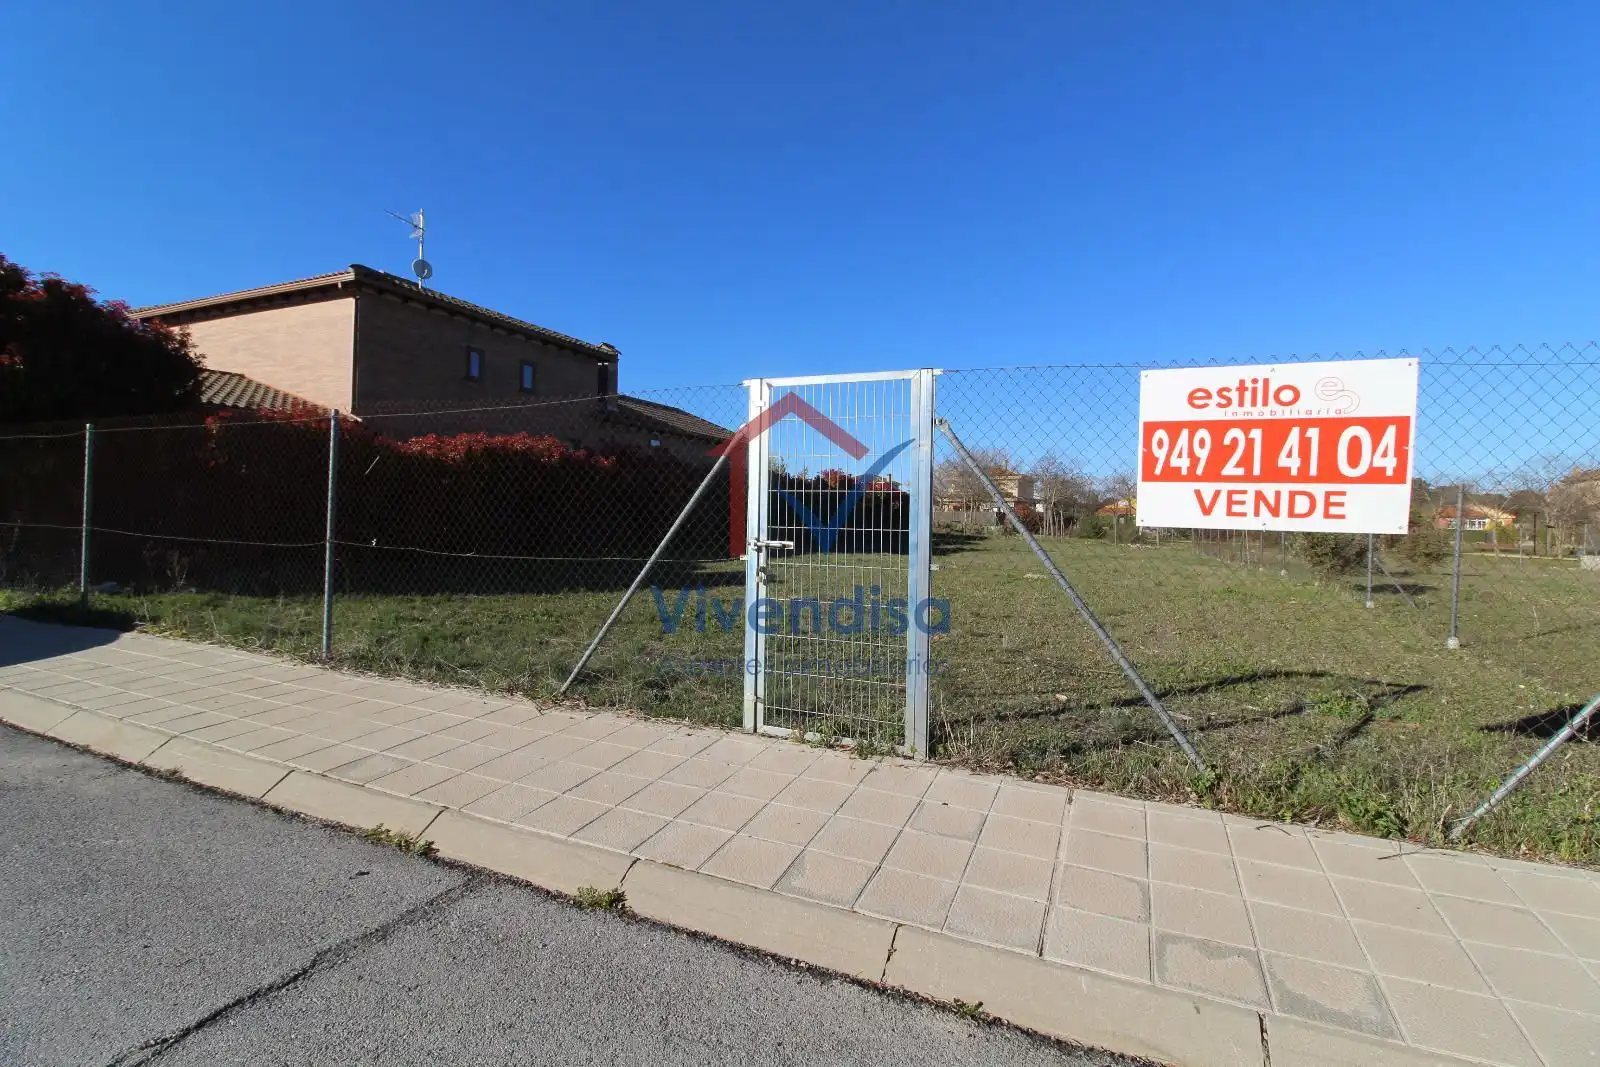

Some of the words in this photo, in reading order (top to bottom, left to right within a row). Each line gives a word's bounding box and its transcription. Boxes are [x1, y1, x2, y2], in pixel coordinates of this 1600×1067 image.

[1187, 377, 1301, 410] estilo
[1224, 407, 1342, 417] inmobiliaria
[1151, 428, 1212, 476] 949
[1220, 427, 1263, 476] 21
[1277, 426, 1320, 476] 41
[1336, 424, 1398, 478] 04
[1193, 489, 1347, 520] VENDE
